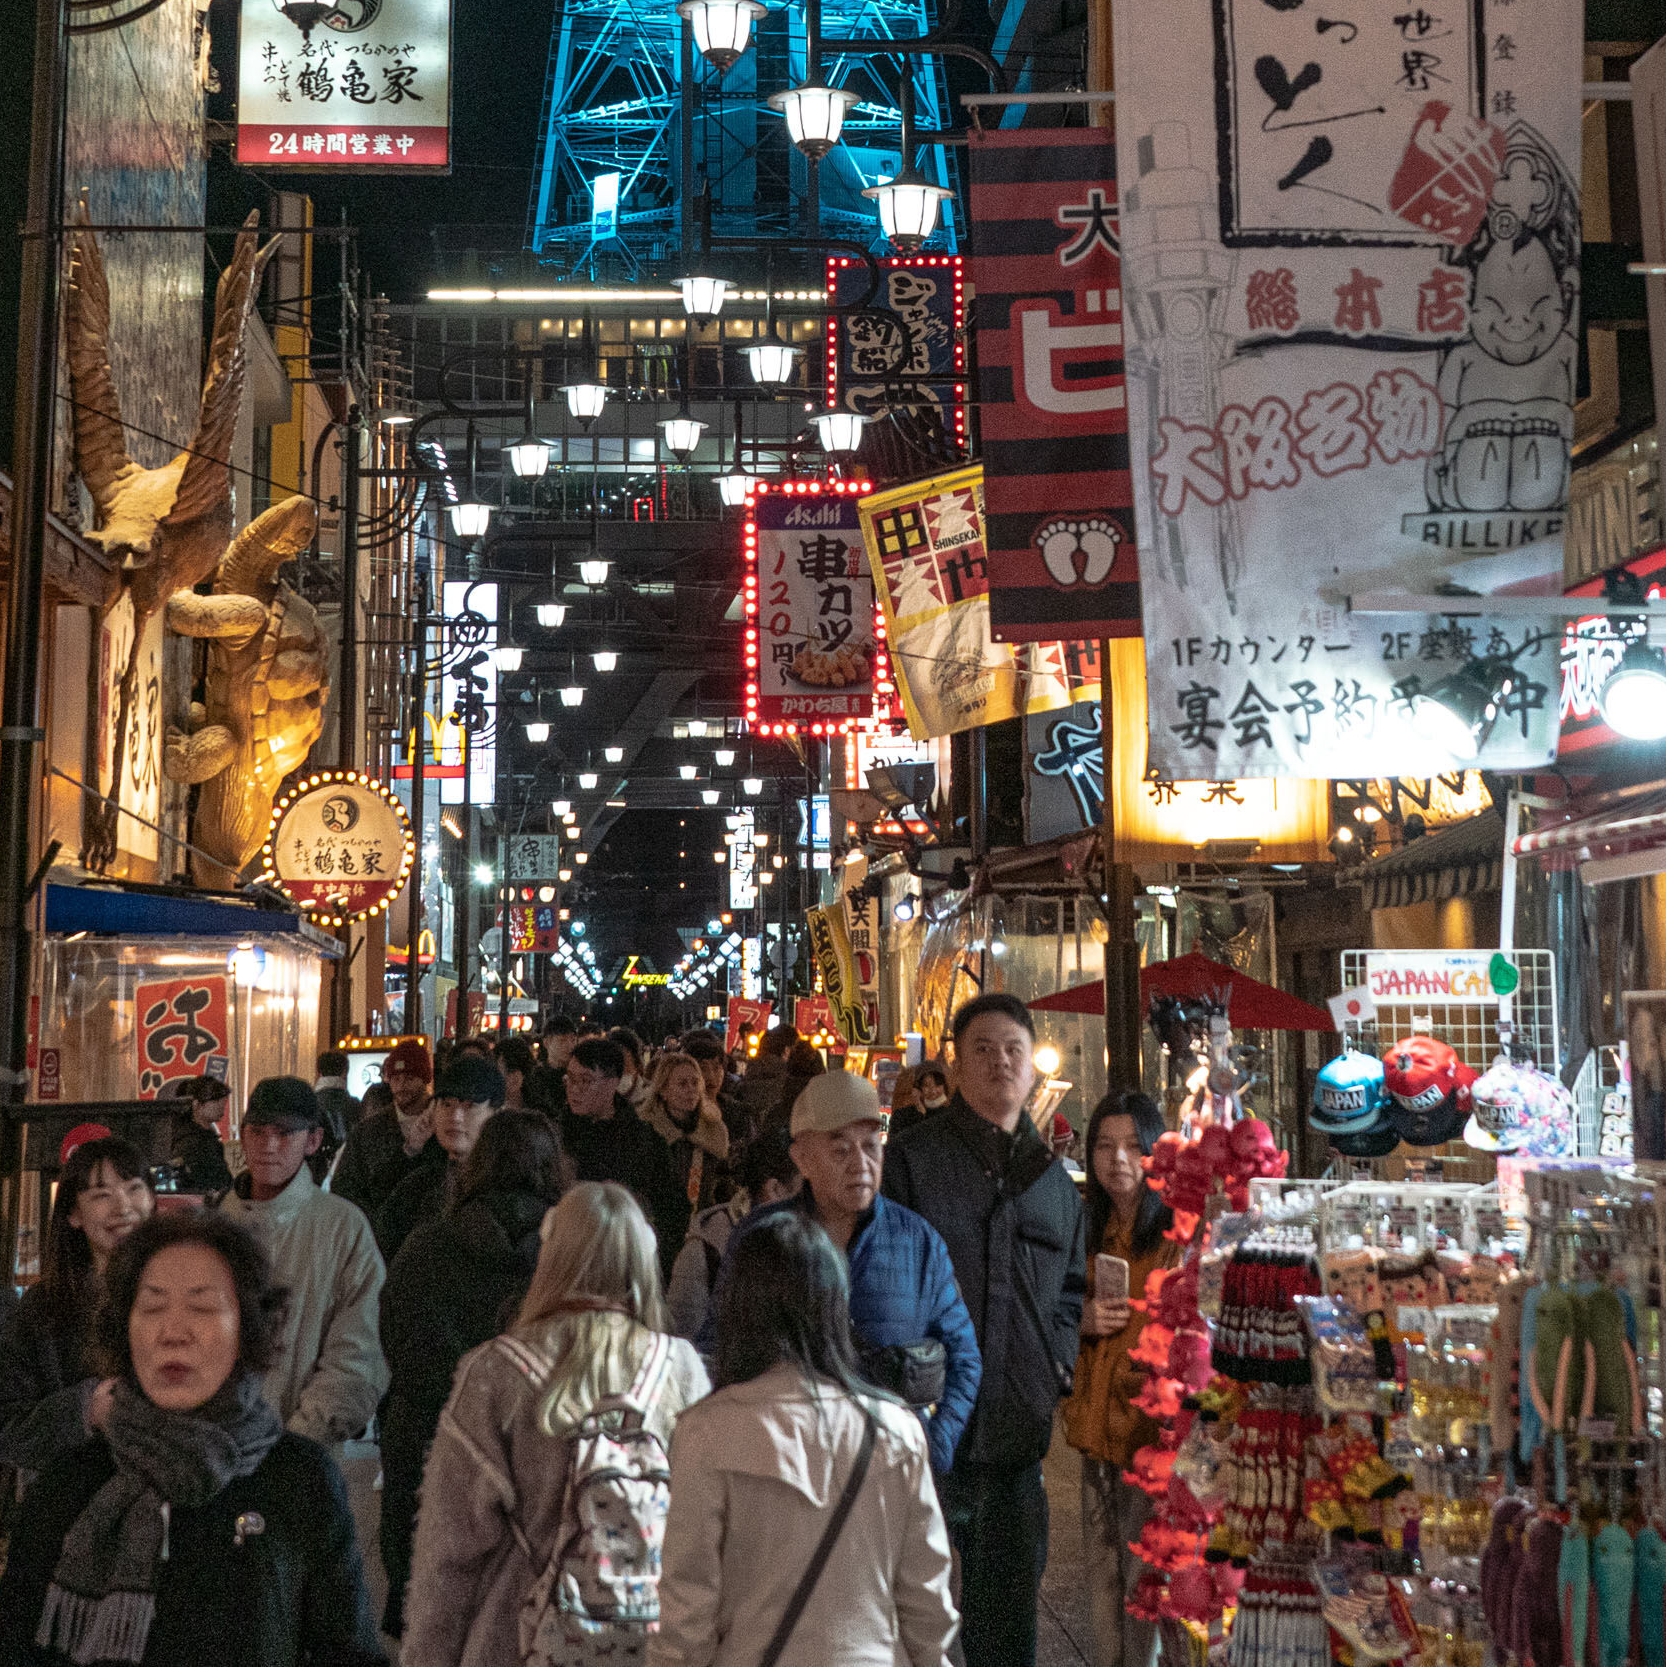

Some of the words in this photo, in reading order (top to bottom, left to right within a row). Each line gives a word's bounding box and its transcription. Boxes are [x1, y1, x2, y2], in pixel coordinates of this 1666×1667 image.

[296, 57, 425, 105] 鶴亀家
[268, 132, 416, 156] 24時間営業中
[1245, 266, 1467, 334] 総本店
[1149, 368, 1446, 516] 大阪名物
[784, 502, 842, 526] Asahi
[796, 534, 854, 652] 串カツ
[781, 696, 849, 714] かわち屋
[313, 848, 386, 877] 鶴亀家
[1370, 968, 1451, 997] JAPAN
